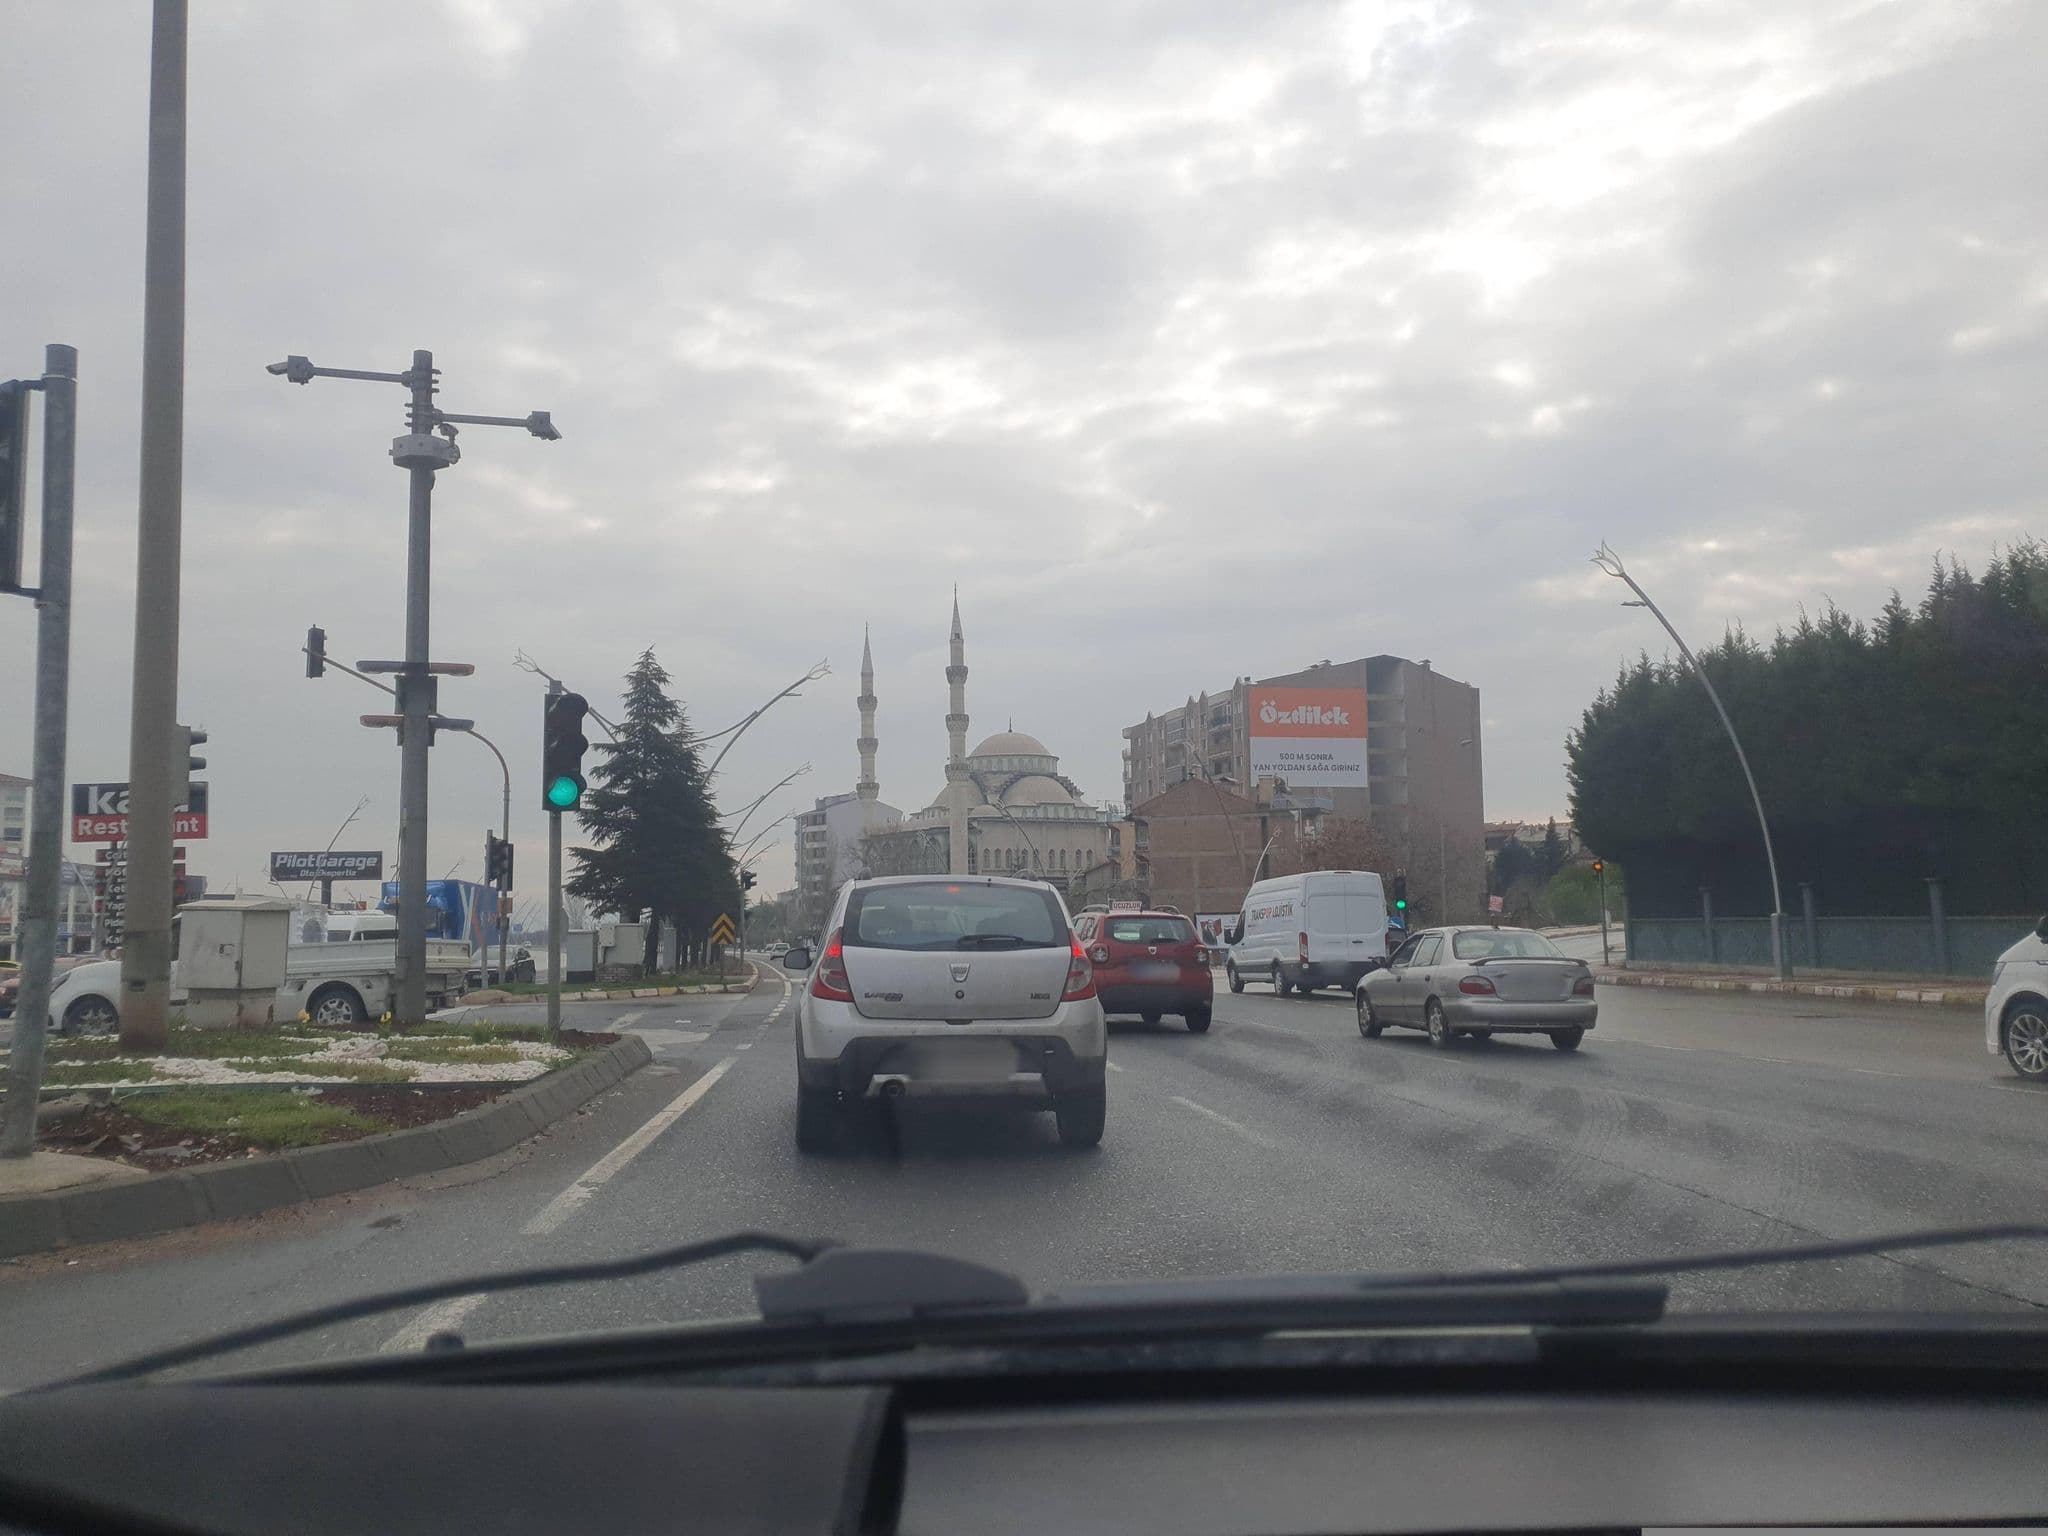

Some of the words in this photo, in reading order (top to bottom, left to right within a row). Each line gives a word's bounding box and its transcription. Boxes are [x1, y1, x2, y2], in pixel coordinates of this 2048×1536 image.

[1260, 700, 1349, 725] Özdilek
[1279, 753, 1295, 761] 500
[1296, 753, 1304, 761] M
[1305, 753, 1334, 761] SONRA
[1253, 763, 1271, 772] YAN
[1272, 763, 1305, 772] YOLDAN
[1306, 762, 1330, 772] SAĞA
